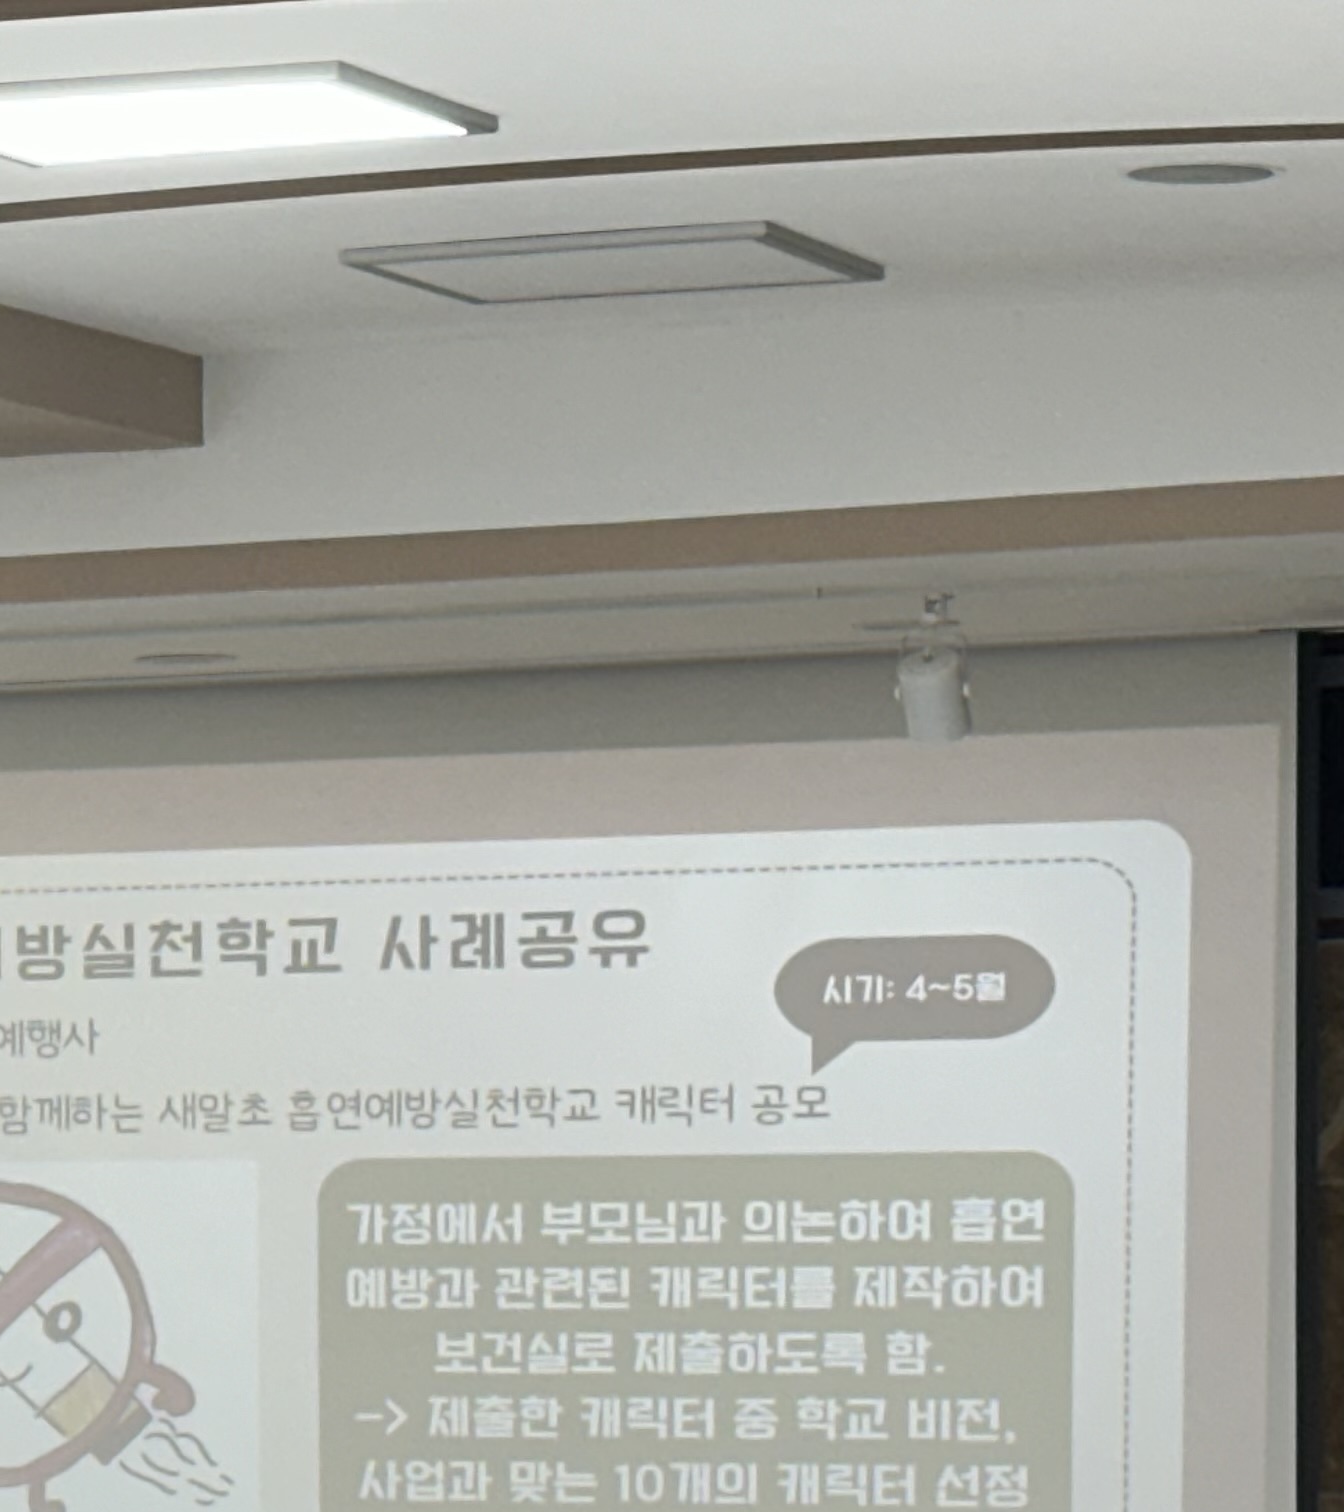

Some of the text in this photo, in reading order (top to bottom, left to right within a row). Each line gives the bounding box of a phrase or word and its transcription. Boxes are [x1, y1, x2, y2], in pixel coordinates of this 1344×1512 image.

[379, 909, 650, 971] 사례공유
[823, 974, 894, 1004] 시기:
[288, 1086, 601, 1133] 흡연예방실천학교
[616, 1083, 735, 1128] 캐릭터
[751, 1084, 831, 1126] 공모
[346, 1196, 1045, 1245] 가정에서 부모님과 의논하여 흡연
[346, 1264, 1044, 1310] 예방과 관련된 캐릭터를 제작하여
[434, 1330, 945, 1376] 보건실로 제출하도록 함.
[428, 1394, 564, 1439] 제출한
[581, 1397, 715, 1440] 캐릭터
[733, 1397, 779, 1440] 중
[797, 1396, 889, 1441] 학교
[908, 1398, 1016, 1444] 비전,
[359, 1459, 1029, 1508] 사업과 맞는 10개의 캐릭터 선정
